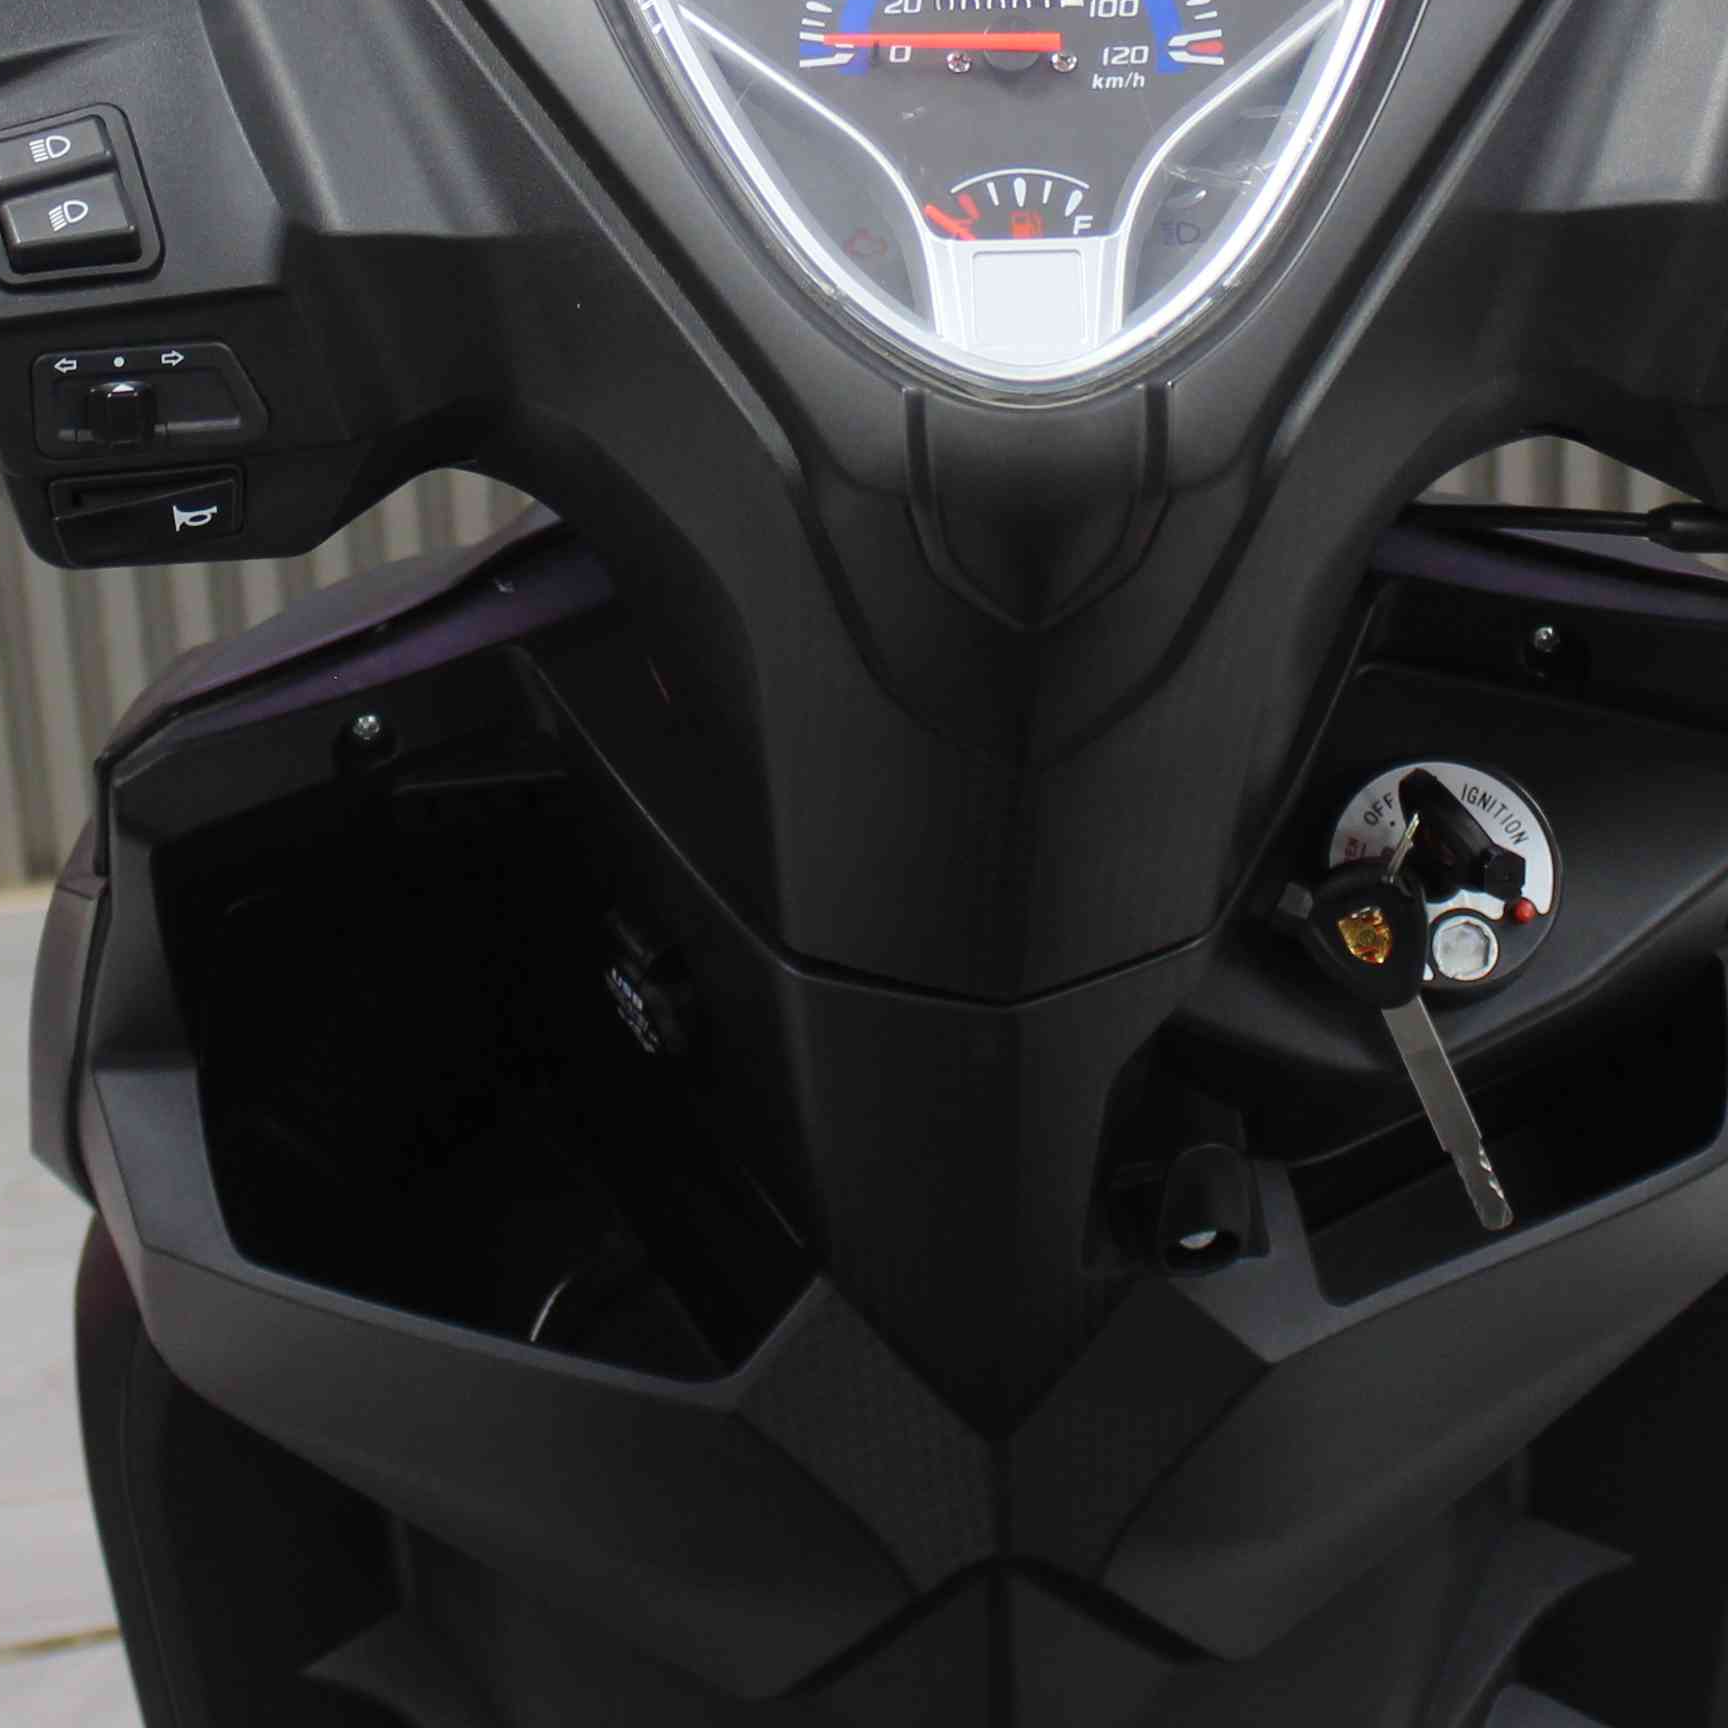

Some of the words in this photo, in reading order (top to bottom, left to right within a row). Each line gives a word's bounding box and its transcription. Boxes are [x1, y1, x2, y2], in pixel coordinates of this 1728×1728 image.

[889, 45, 912, 63] 0
[1103, 45, 1149, 66] 120
[1092, 72, 1145, 89] km/h
[1073, 215, 1094, 235] F
[1363, 792, 1394, 826] OFF
[1460, 783, 1530, 845] IGNITION
